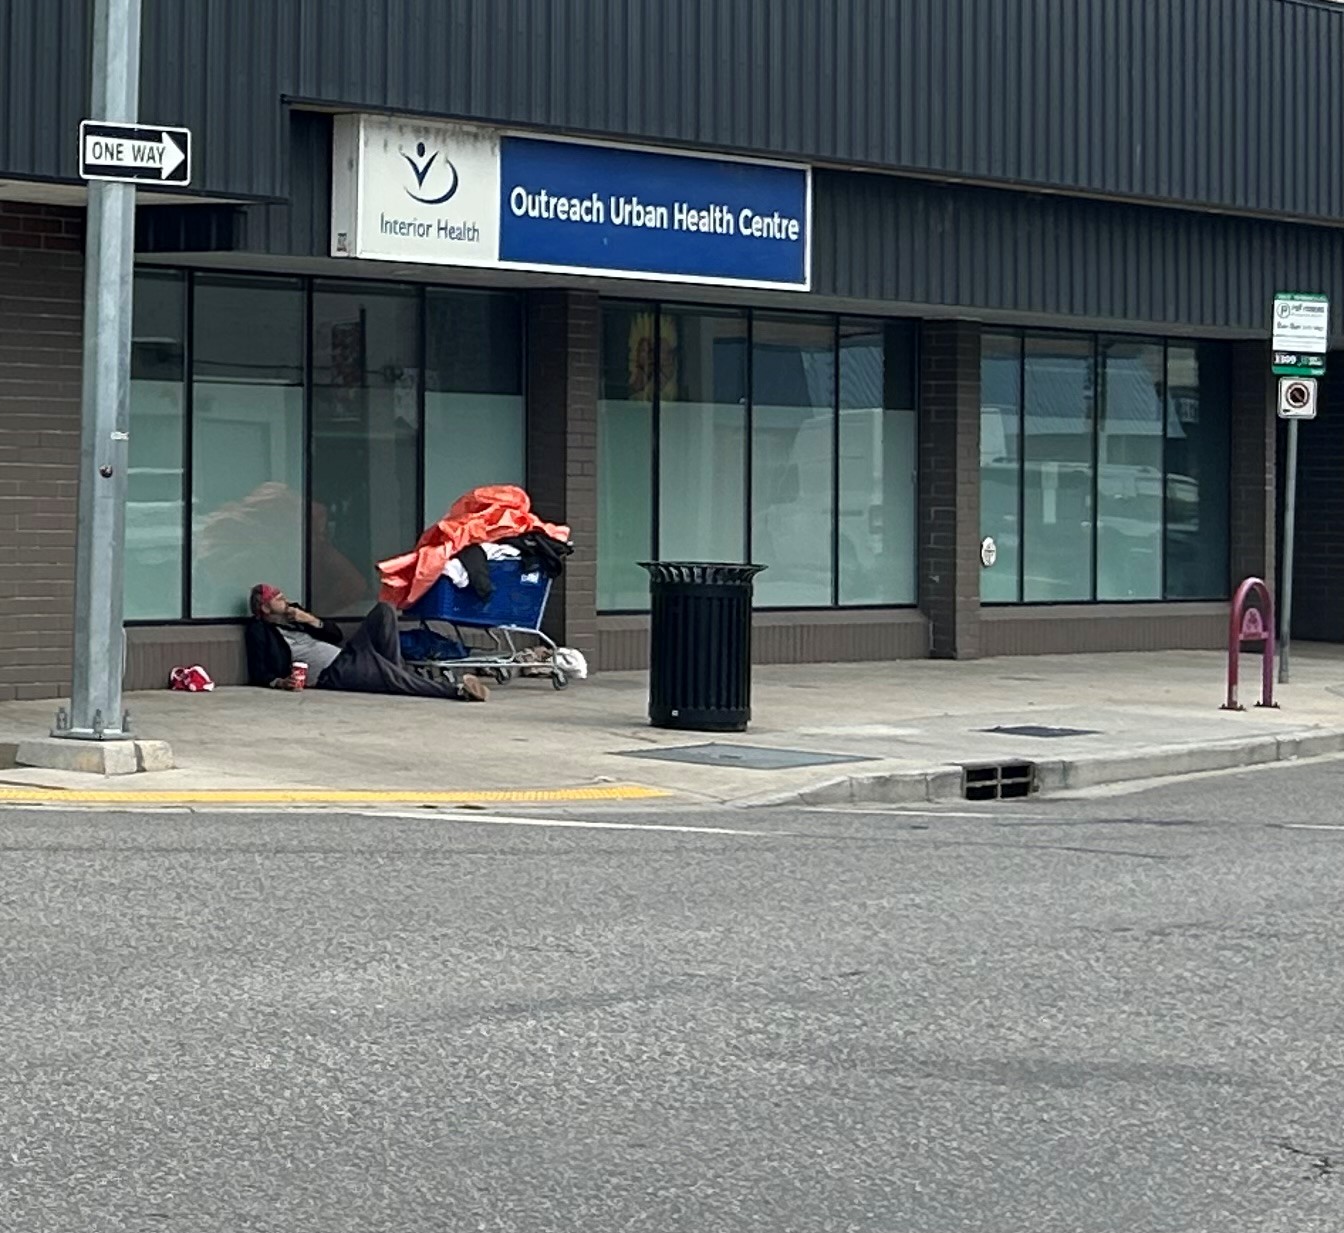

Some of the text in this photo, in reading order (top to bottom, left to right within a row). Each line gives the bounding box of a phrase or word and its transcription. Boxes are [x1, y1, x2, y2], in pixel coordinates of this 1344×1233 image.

[92, 141, 166, 164] ONE WAY
[380, 212, 480, 243] Interior Health
[510, 186, 800, 241] Outreach Urban Health Centre
